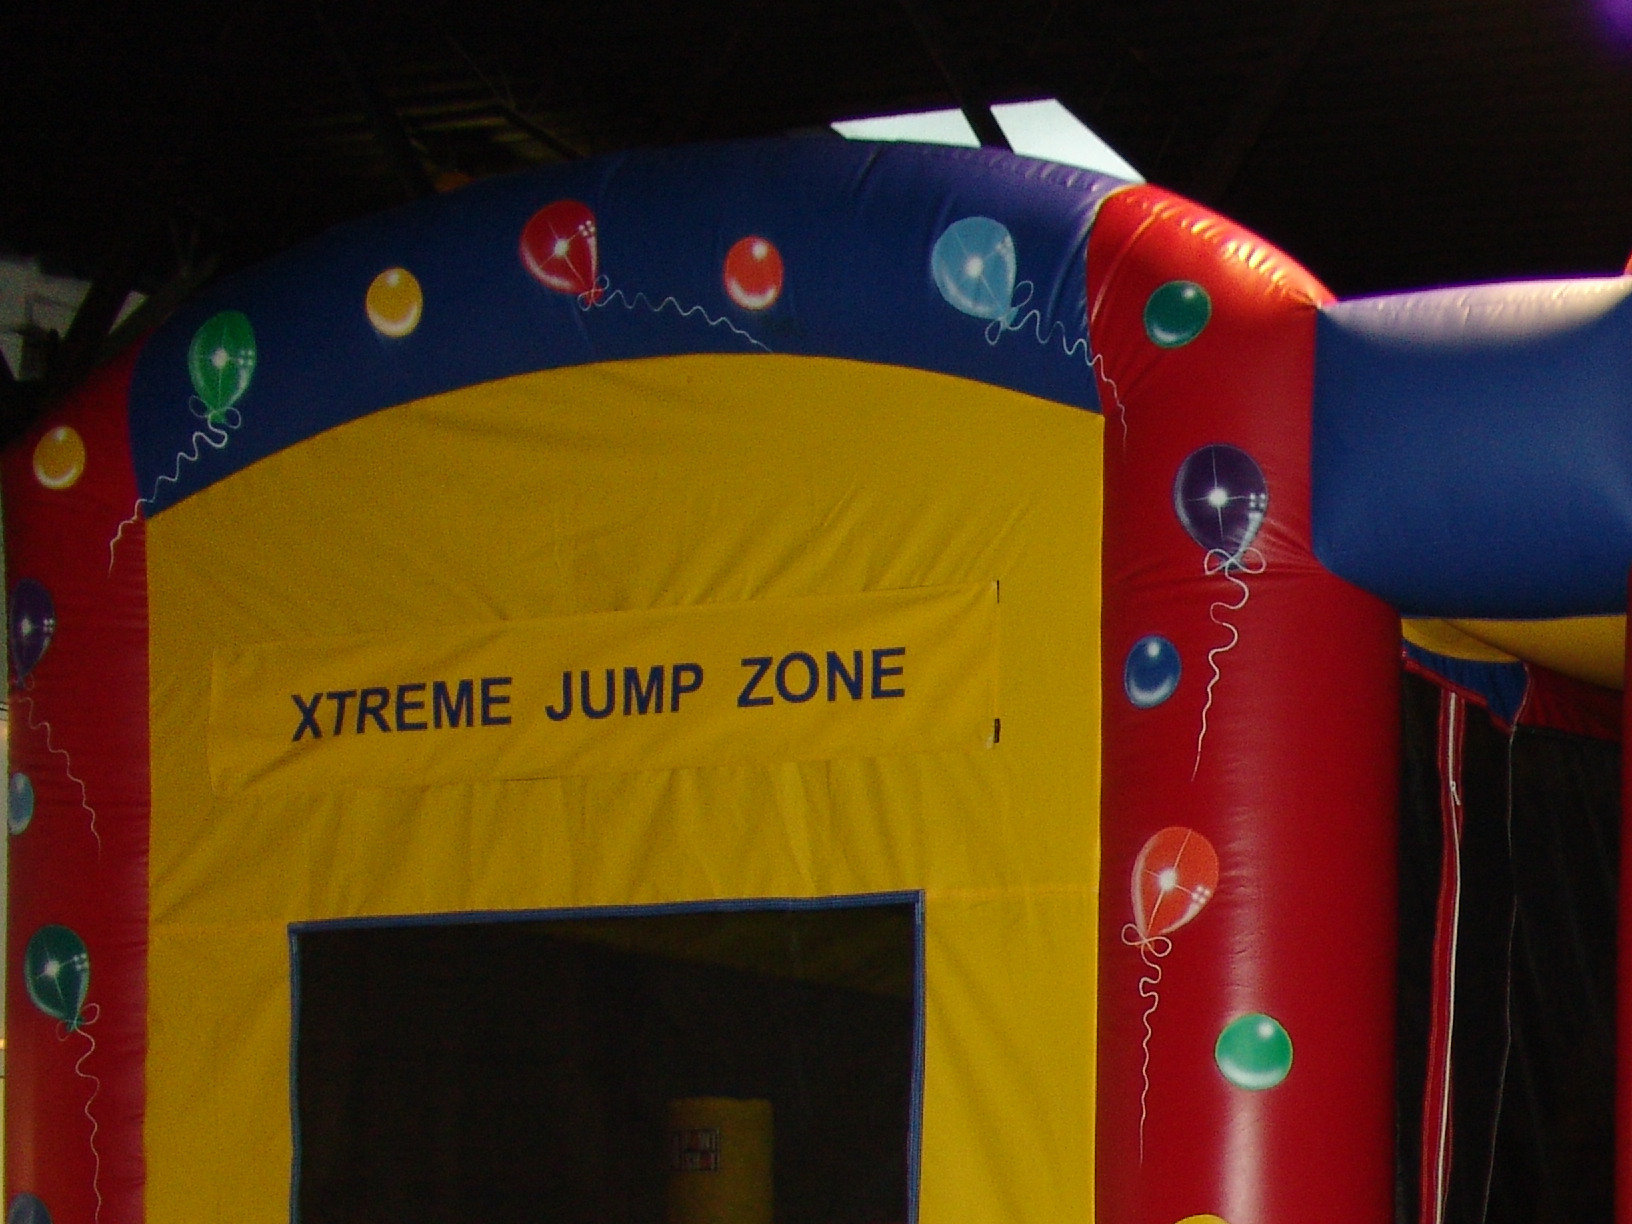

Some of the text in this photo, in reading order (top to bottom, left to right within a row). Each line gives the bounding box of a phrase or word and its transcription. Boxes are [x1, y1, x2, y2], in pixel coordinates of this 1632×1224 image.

[290, 647, 907, 742] XTREME JUMP ZONE
